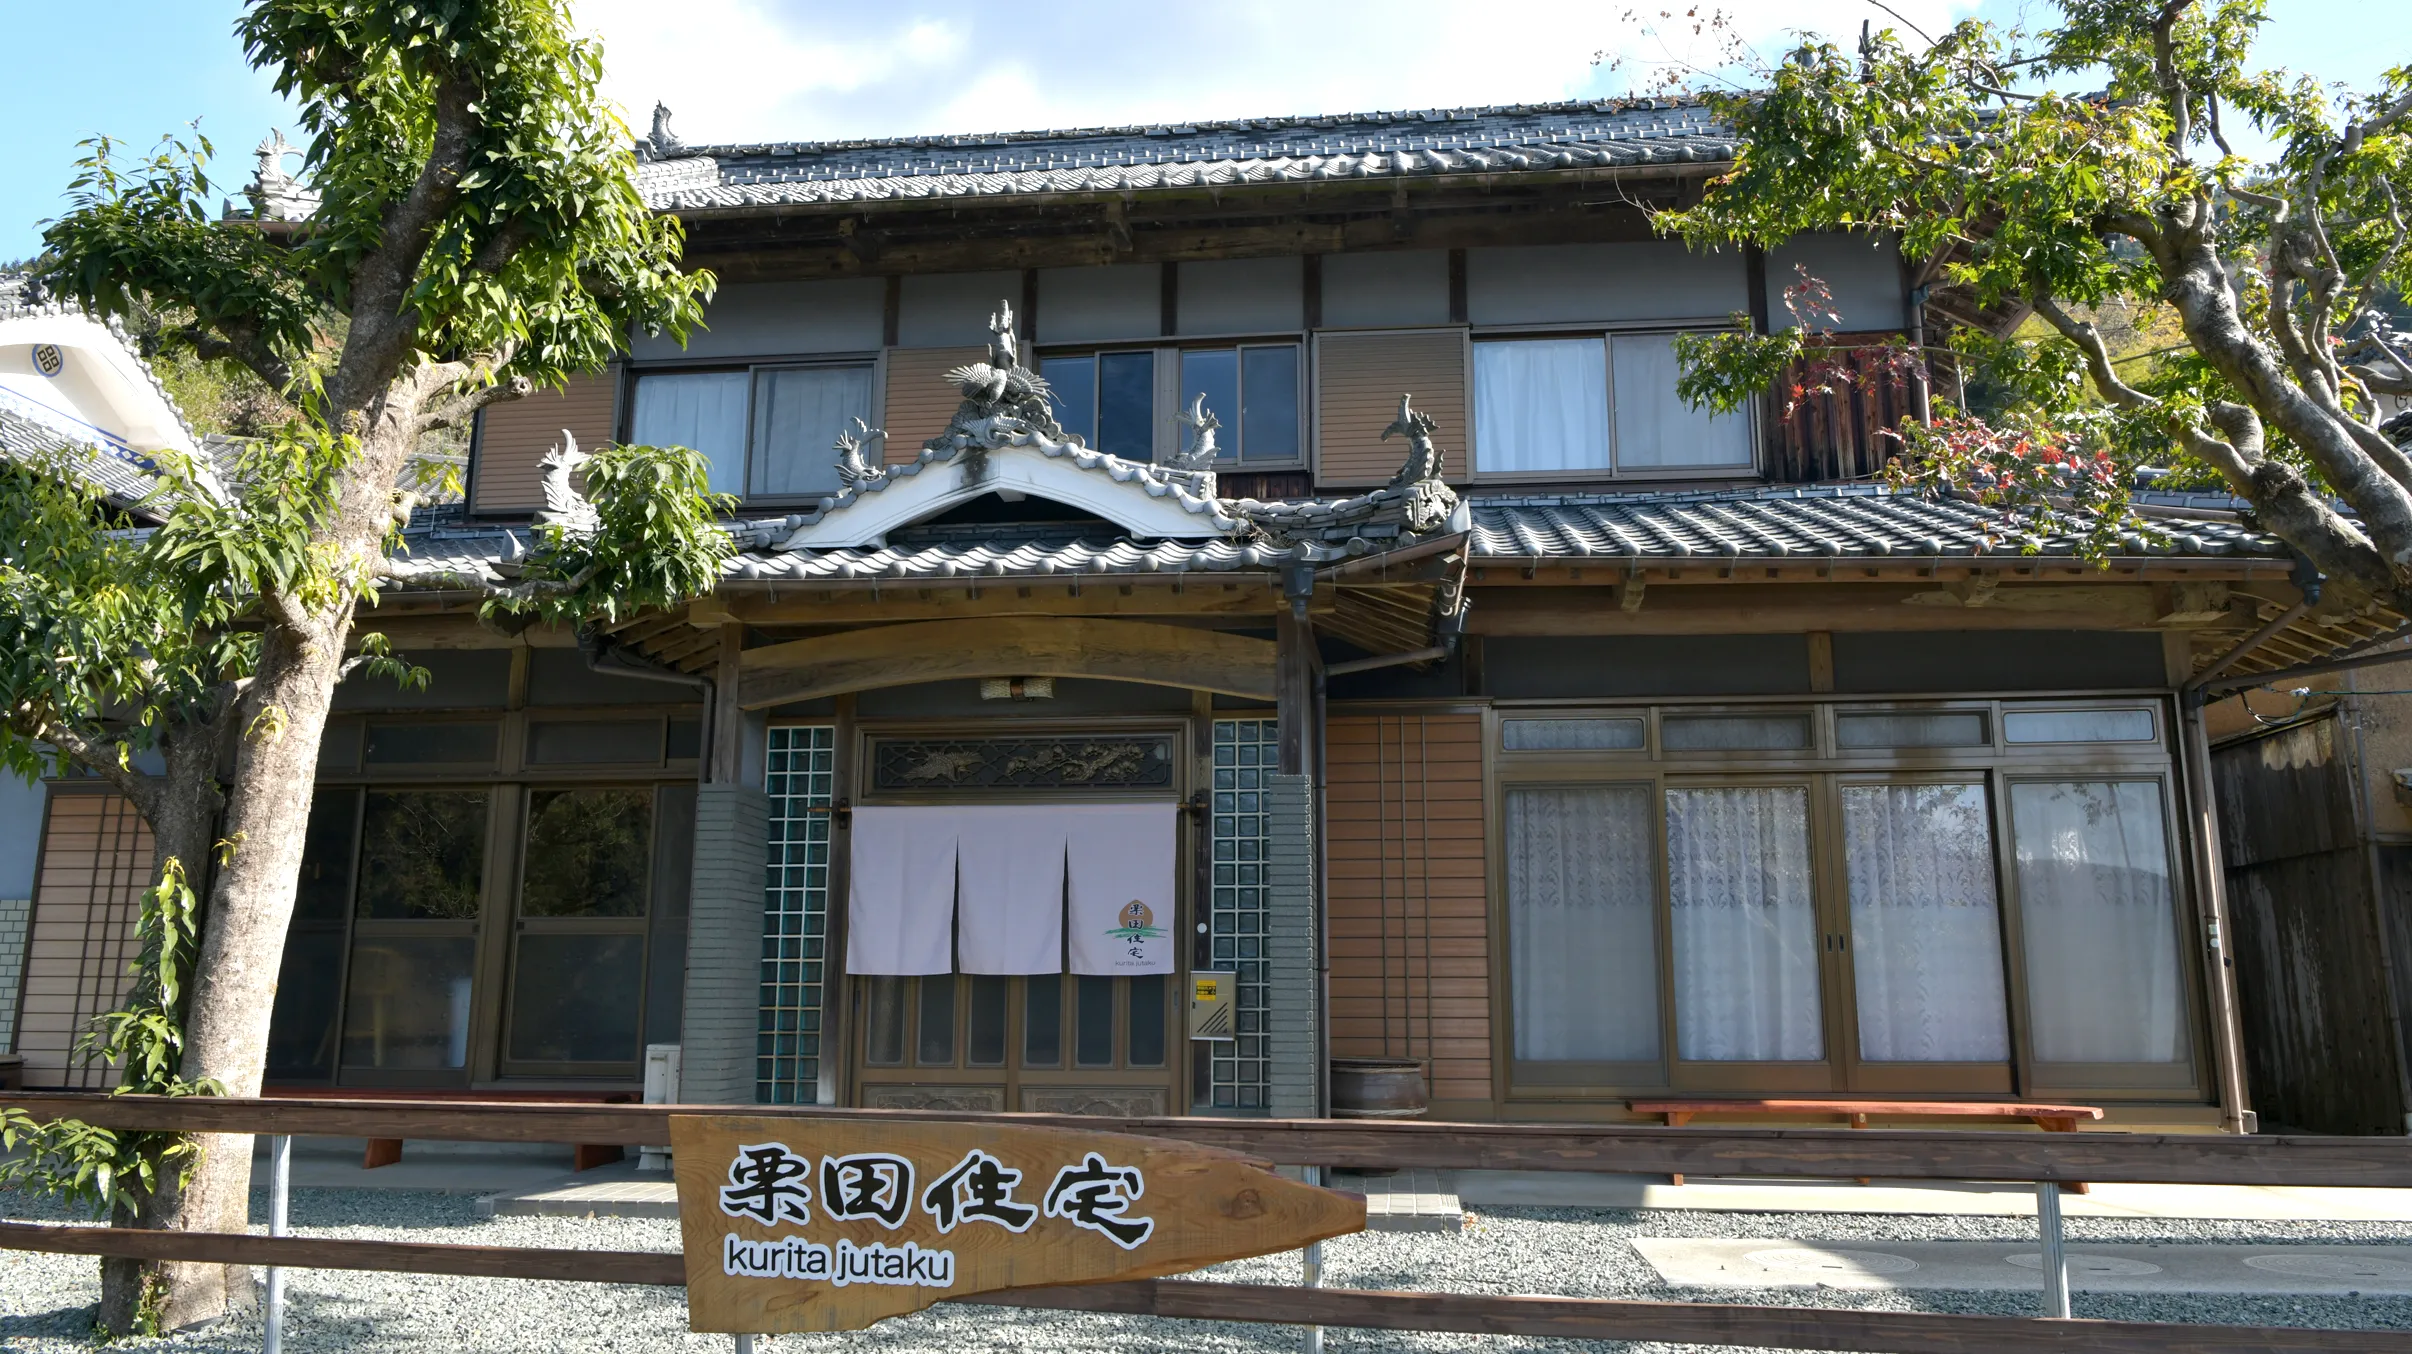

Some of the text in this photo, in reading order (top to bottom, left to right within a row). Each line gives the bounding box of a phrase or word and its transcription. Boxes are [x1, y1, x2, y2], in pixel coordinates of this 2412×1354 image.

[1127, 903, 1145, 959] 栗田住宅
[1135, 960, 1156, 968] jutaku
[723, 1146, 1149, 1245] 栗田住宅
[728, 1239, 948, 1282] kurita jutaku
